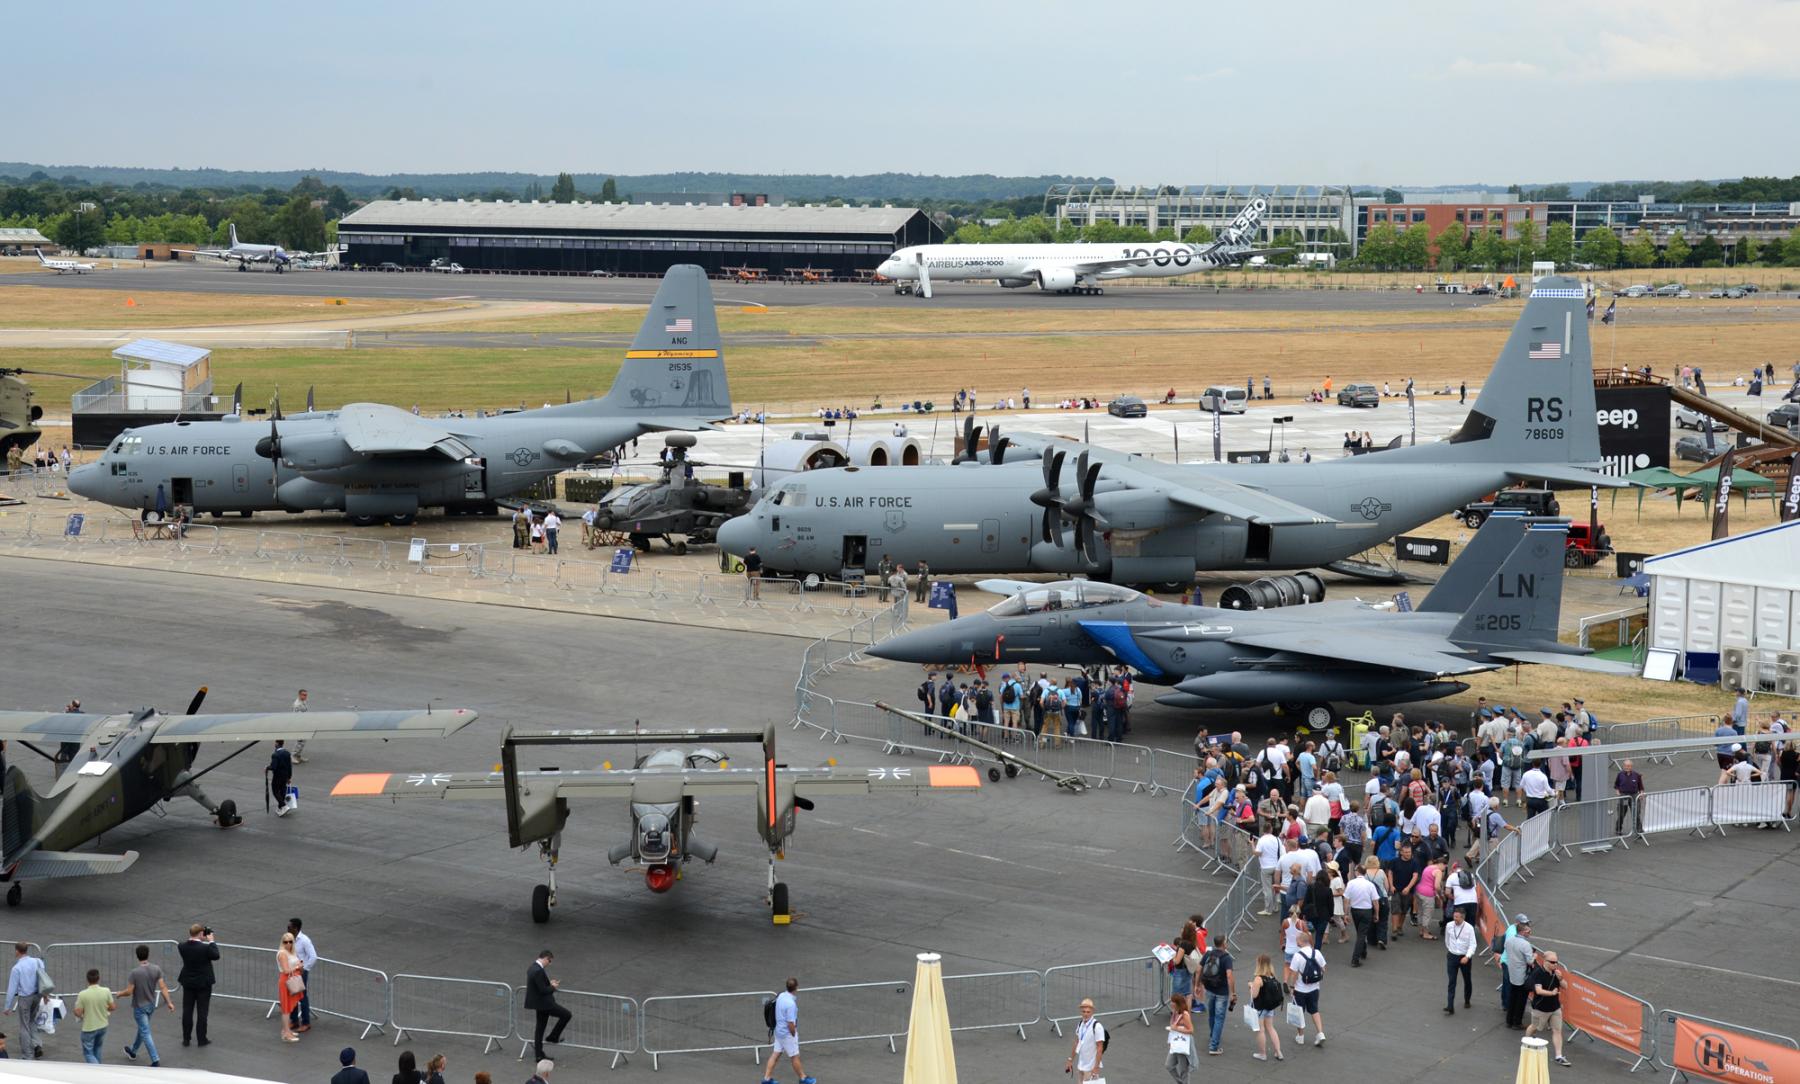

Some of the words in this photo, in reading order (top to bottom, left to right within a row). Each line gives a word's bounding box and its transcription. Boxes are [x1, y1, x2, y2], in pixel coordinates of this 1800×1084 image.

[1229, 198, 1266, 241] A350
[928, 260, 964, 268] AIRBUS
[1122, 248, 1191, 267] 1000
[671, 337, 688, 345] ANG
[668, 363, 692, 371] 21535
[1527, 397, 1564, 424] RS
[1596, 408, 1638, 429] eep
[1525, 428, 1564, 440] 78609
[171, 446, 188, 455] AIR
[193, 446, 231, 455] FORCE
[844, 496, 864, 508] AIR
[870, 496, 913, 508] FORCE
[1716, 475, 1732, 513] Jeep
[1786, 475, 1800, 513] Jeep
[1498, 573, 1535, 598] LN
[1487, 614, 1521, 631] 205
[1703, 1039, 1741, 1070] HELI
[1724, 1063, 1774, 1084] OPERATIONS
